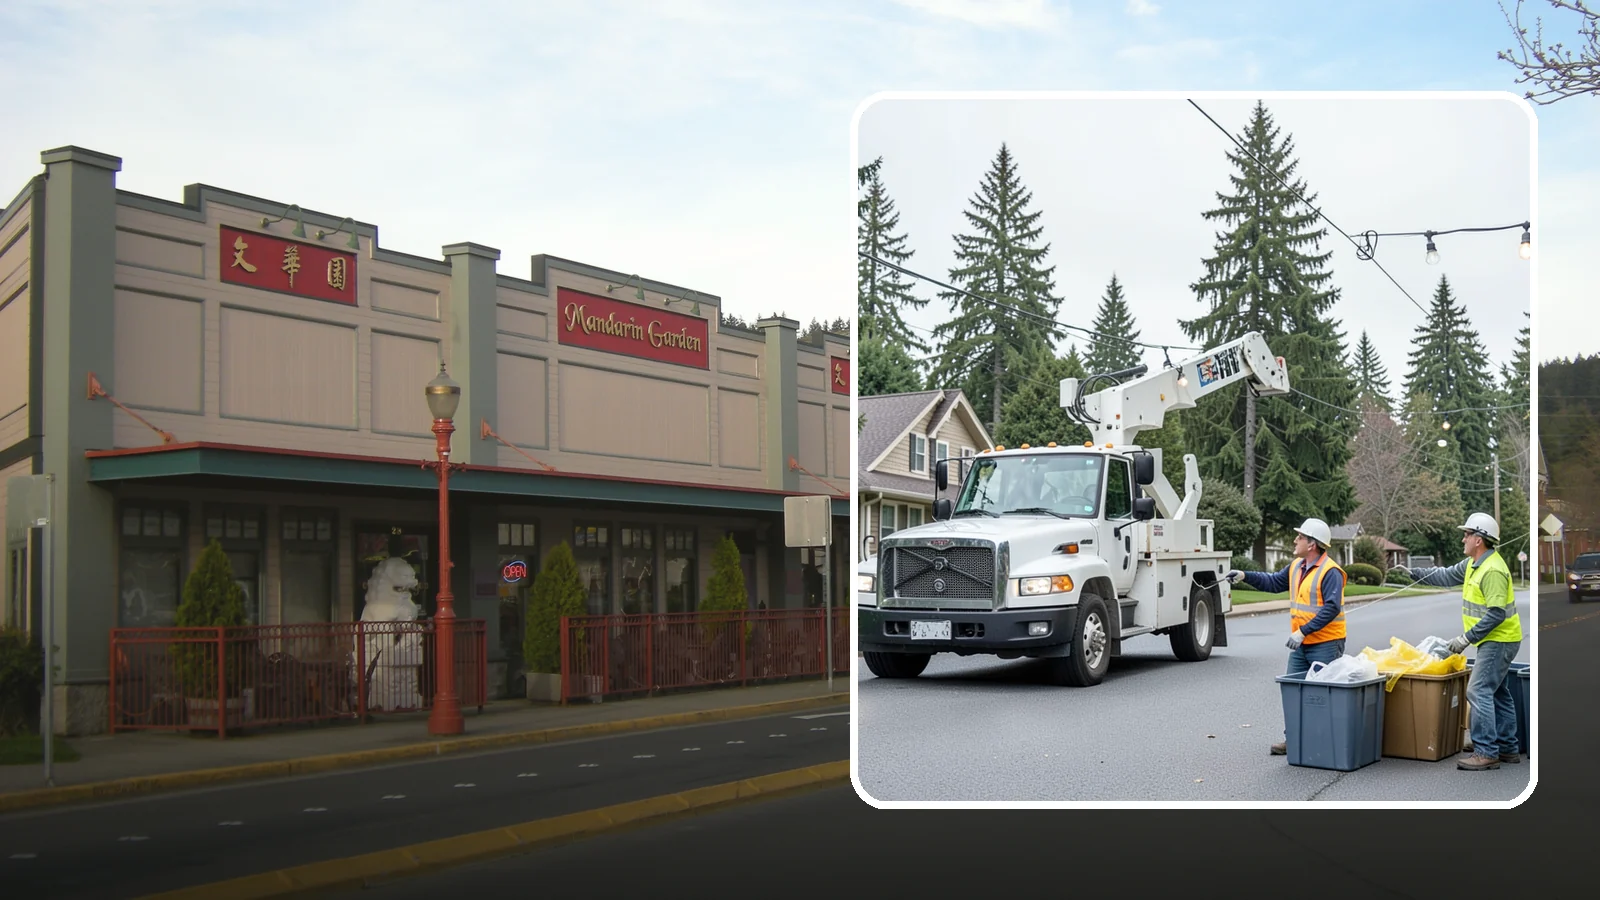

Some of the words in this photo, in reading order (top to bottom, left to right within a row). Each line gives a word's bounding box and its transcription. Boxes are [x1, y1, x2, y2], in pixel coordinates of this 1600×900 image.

[564, 302, 644, 341] Mandarin
[648, 320, 701, 352] Garden
[503, 565, 527, 578] OPEN
